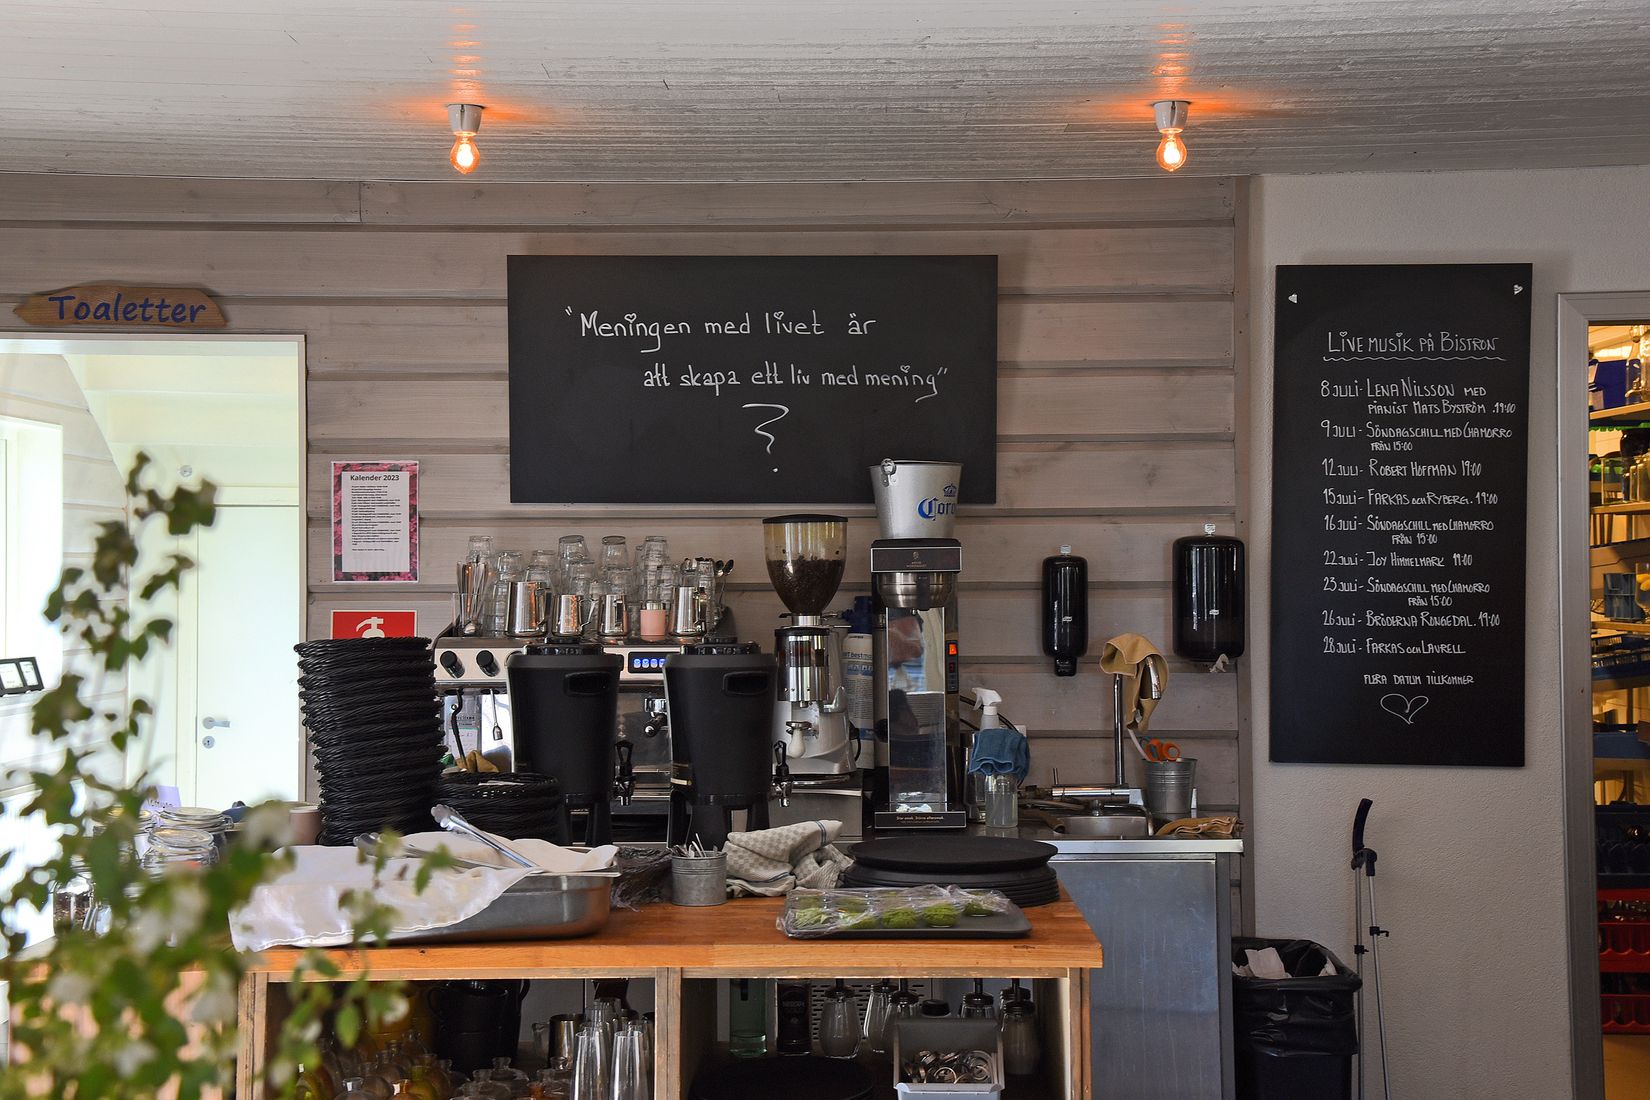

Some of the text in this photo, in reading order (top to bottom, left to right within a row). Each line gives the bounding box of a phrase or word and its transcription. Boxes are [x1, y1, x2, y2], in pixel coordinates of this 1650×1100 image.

[48, 293, 207, 323] Toaletter
[704, 312, 750, 335] med
[765, 310, 825, 336] livet
[847, 312, 876, 335] är
[643, 362, 670, 387] att
[680, 364, 741, 396] skapa
[750, 360, 784, 386] ett
[791, 364, 810, 386] liv
[822, 365, 858, 387] med
[1367, 378, 1399, 397] LENA
[1463, 386, 1486, 396] MED
[1367, 400, 1408, 414] PIANIST
[1412, 400, 1441, 414] MATS
[742, 402, 790, 473] ?
[1370, 441, 1413, 451] FRÅN 15:00
[1368, 458, 1407, 476] ROBERT
[1461, 460, 1481, 476] 19:00
[350, 474, 400, 482] Kalender 2023
[1367, 488, 1410, 505] FARKAS
[1475, 491, 1498, 505] 19:00
[1391, 532, 1438, 545] FRÅN 15:00
[1366, 551, 1387, 566] JOY
[1407, 595, 1453, 606] FRÅN 15:00
[1478, 611, 1500, 627] 19:00
[1366, 637, 1405, 654] FARKAS
[1393, 674, 1422, 685] DATUM
